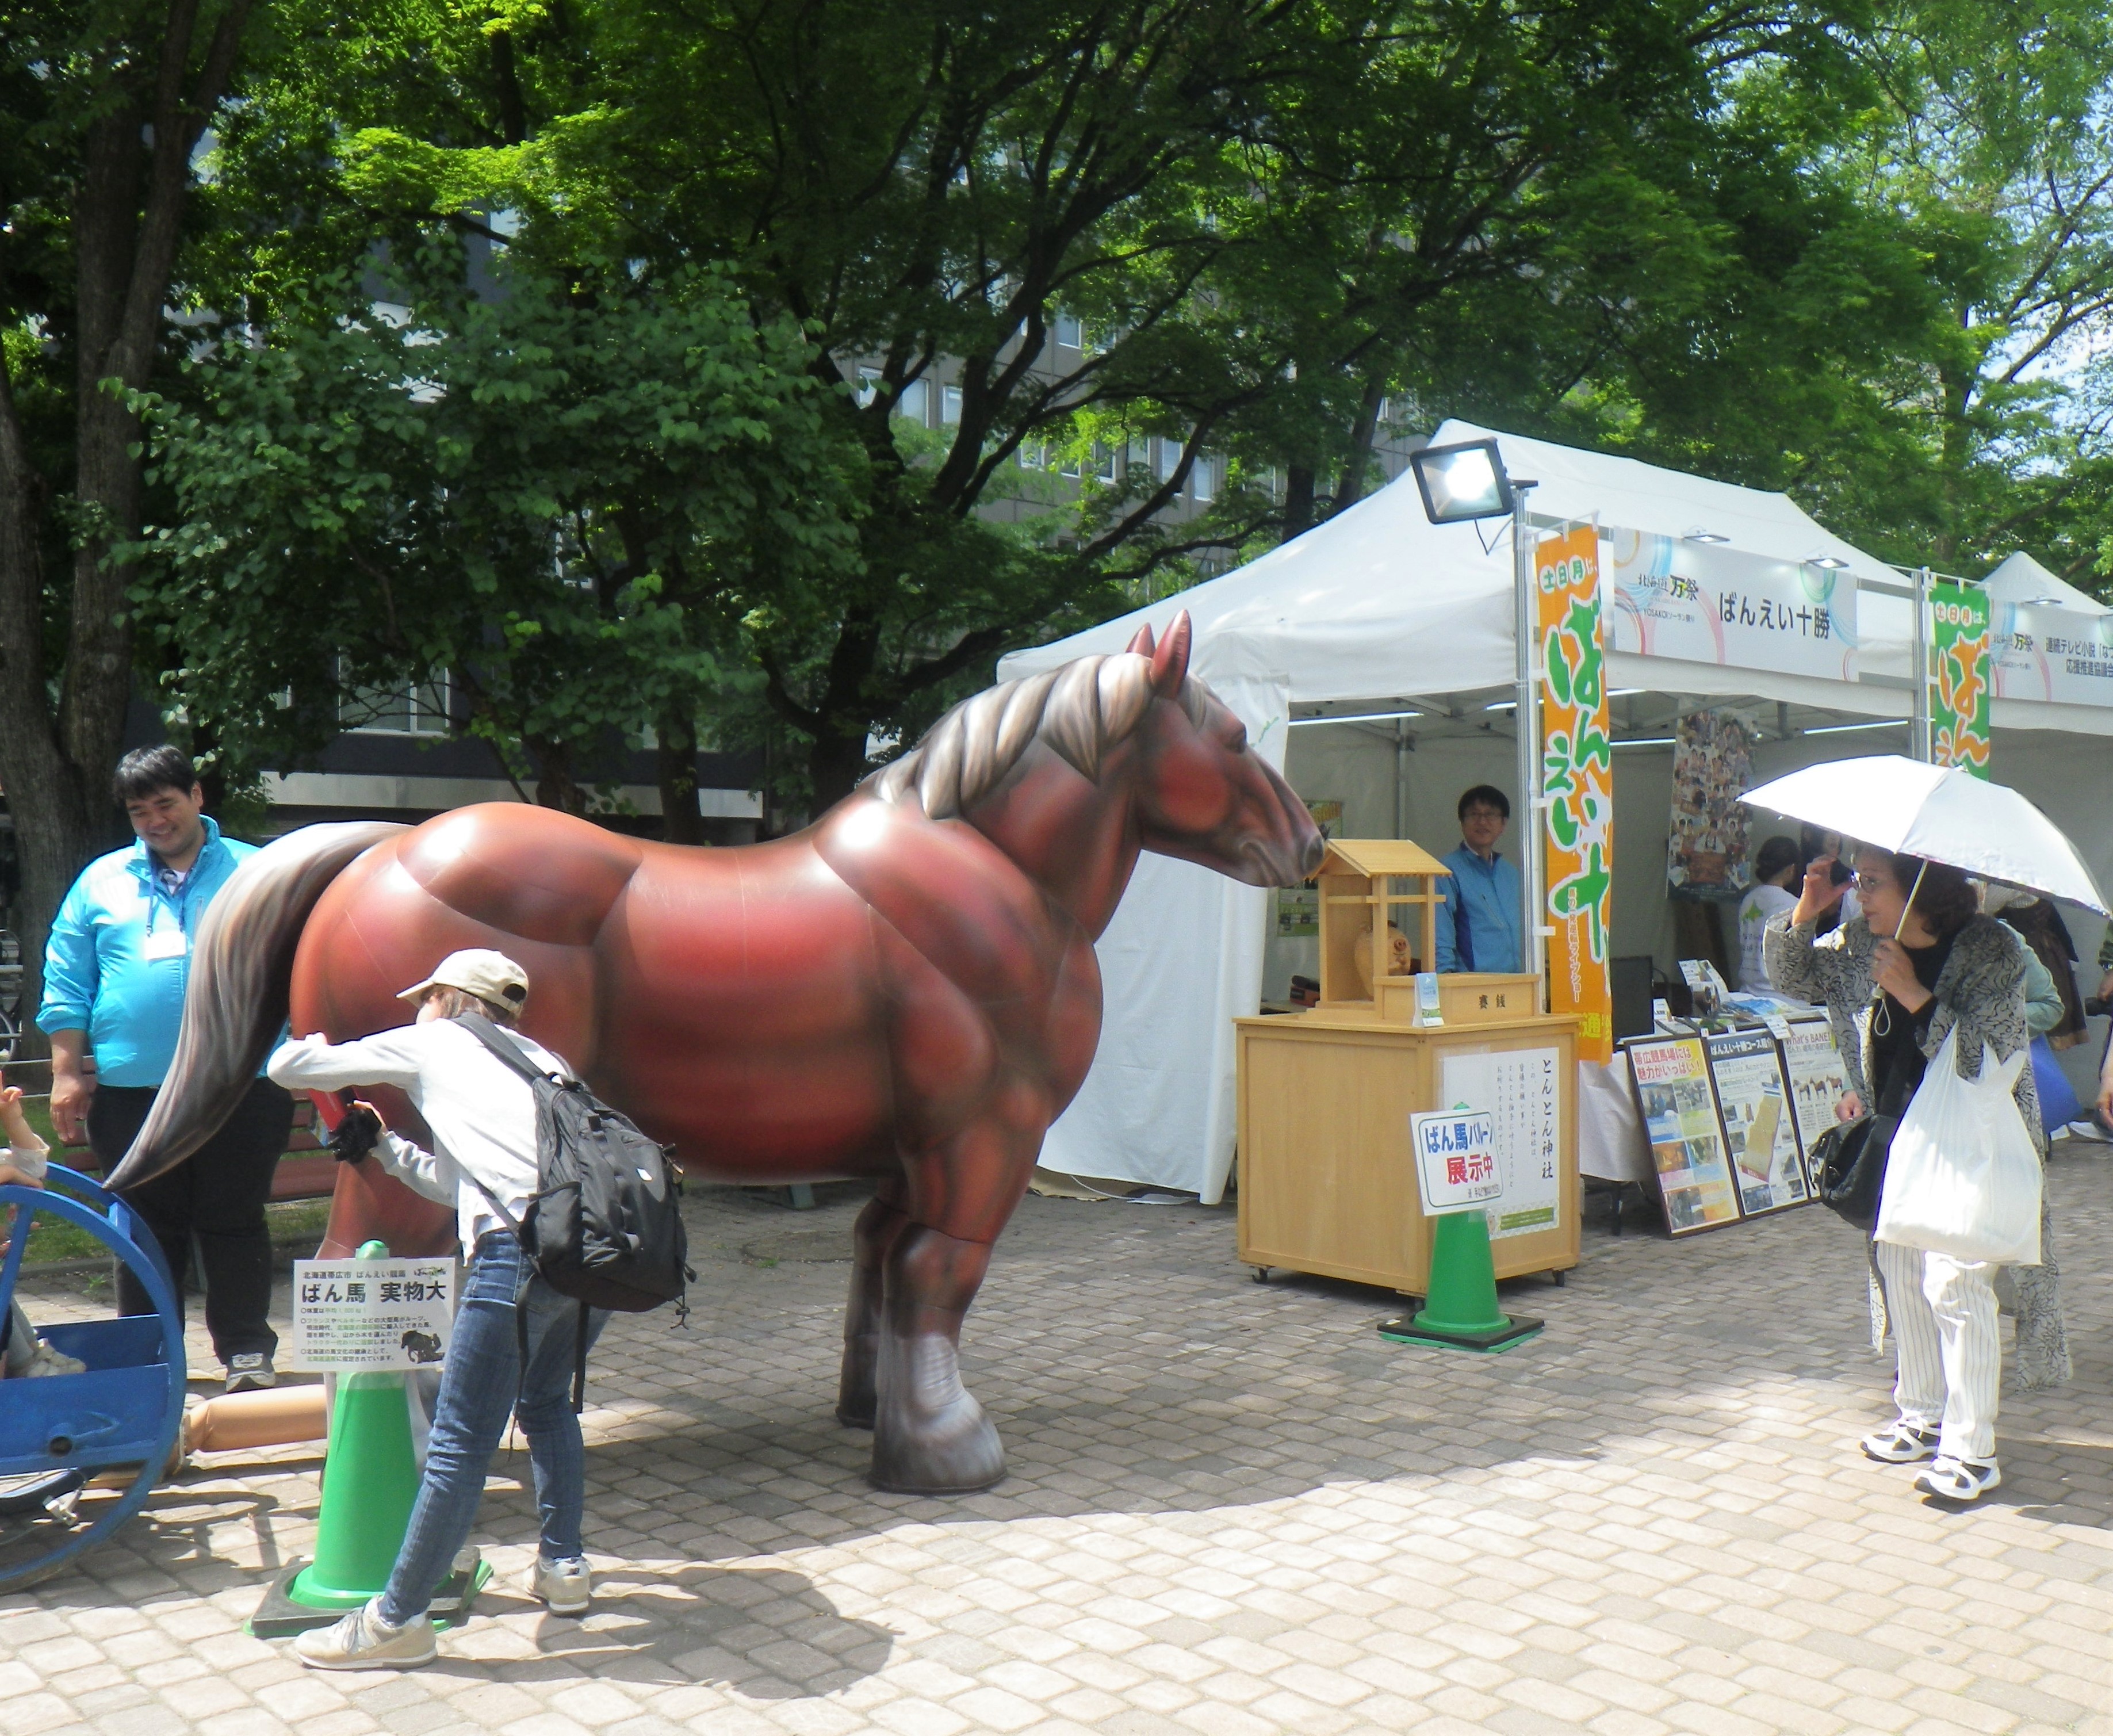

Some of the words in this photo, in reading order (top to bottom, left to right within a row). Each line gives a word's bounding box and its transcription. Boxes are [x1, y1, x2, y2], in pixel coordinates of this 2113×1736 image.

[1720, 591, 1830, 640] ばんえい十勝
[1541, 1059, 1553, 1179] とんとん神社
[1446, 1152, 1494, 1185] 展示中
[302, 1283, 366, 1303] ばん馬
[380, 1280, 447, 1303] 実物大
